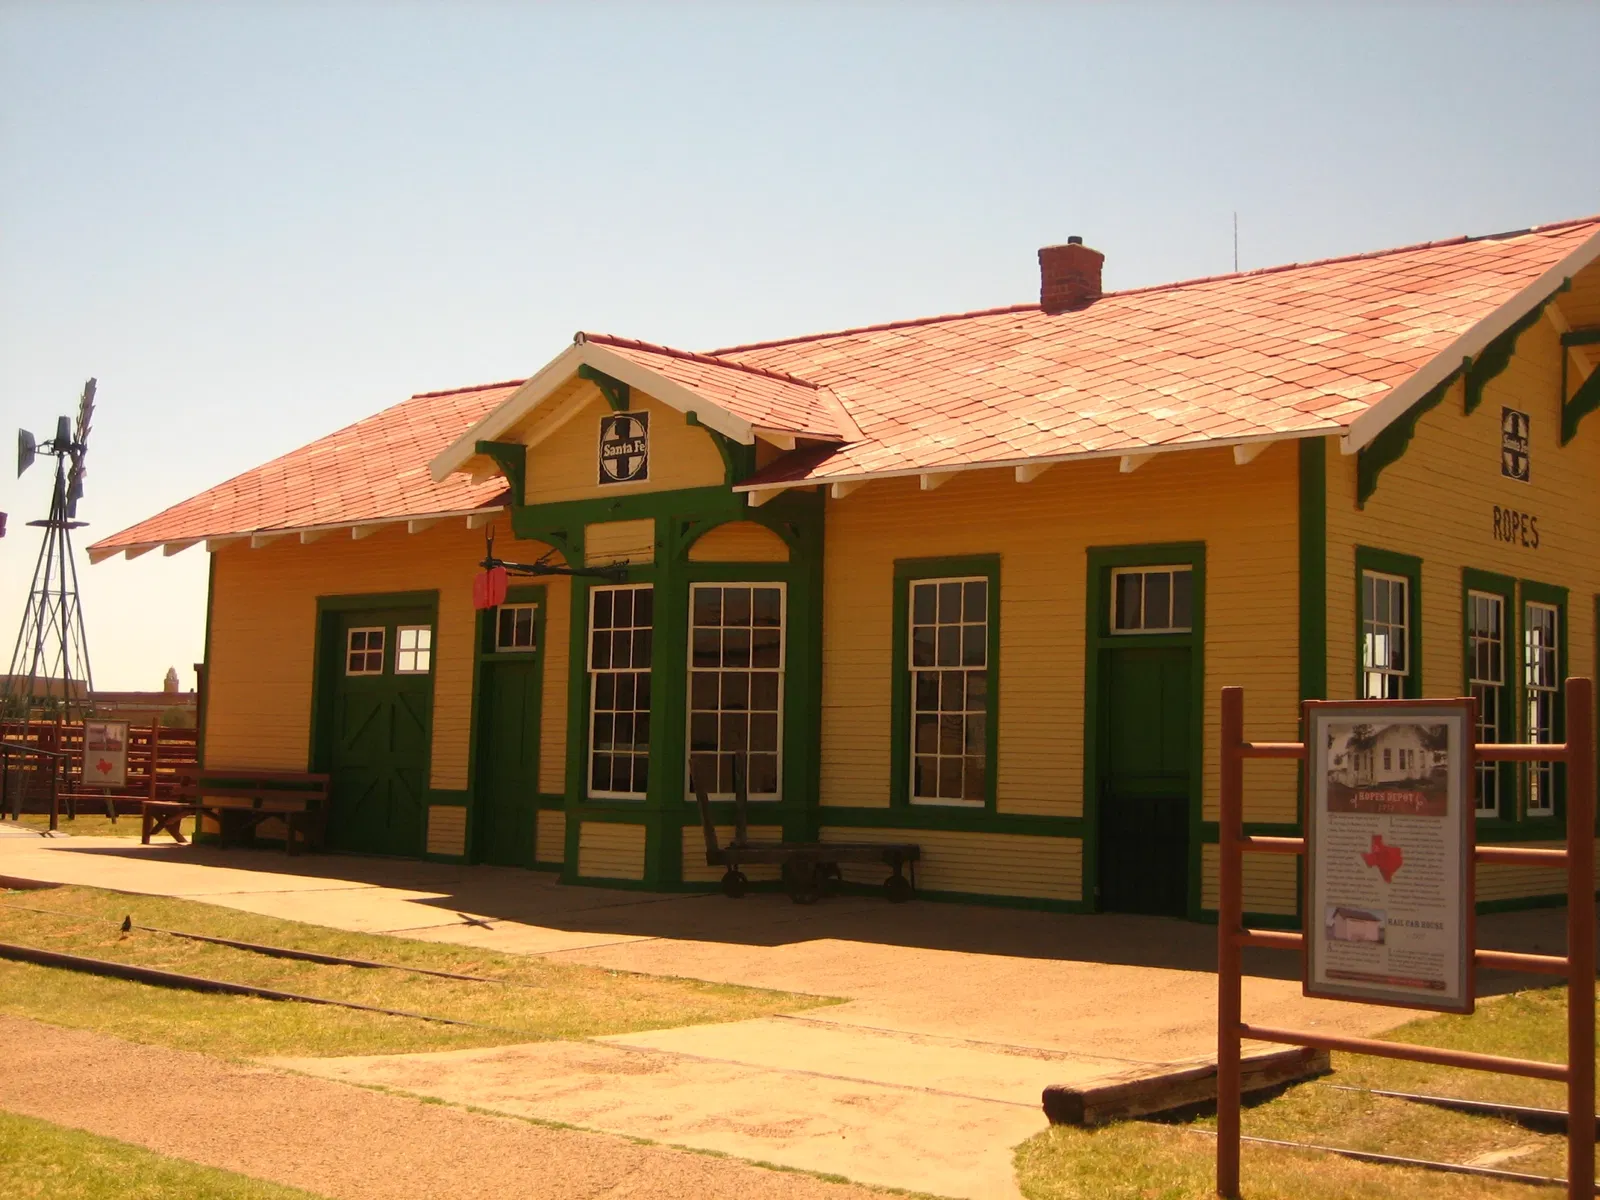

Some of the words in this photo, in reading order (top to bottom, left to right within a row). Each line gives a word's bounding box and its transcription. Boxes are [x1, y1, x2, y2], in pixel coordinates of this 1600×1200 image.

[604, 443, 632, 457] Santa
[634, 440, 645, 453] Fe
[1493, 505, 1539, 549] ROPES
[1359, 792, 1385, 801] ROPES
[1387, 792, 1413, 802] DEPOT
[1388, 918, 1404, 927] RAIL
[1421, 921, 1444, 930] HOUSE
